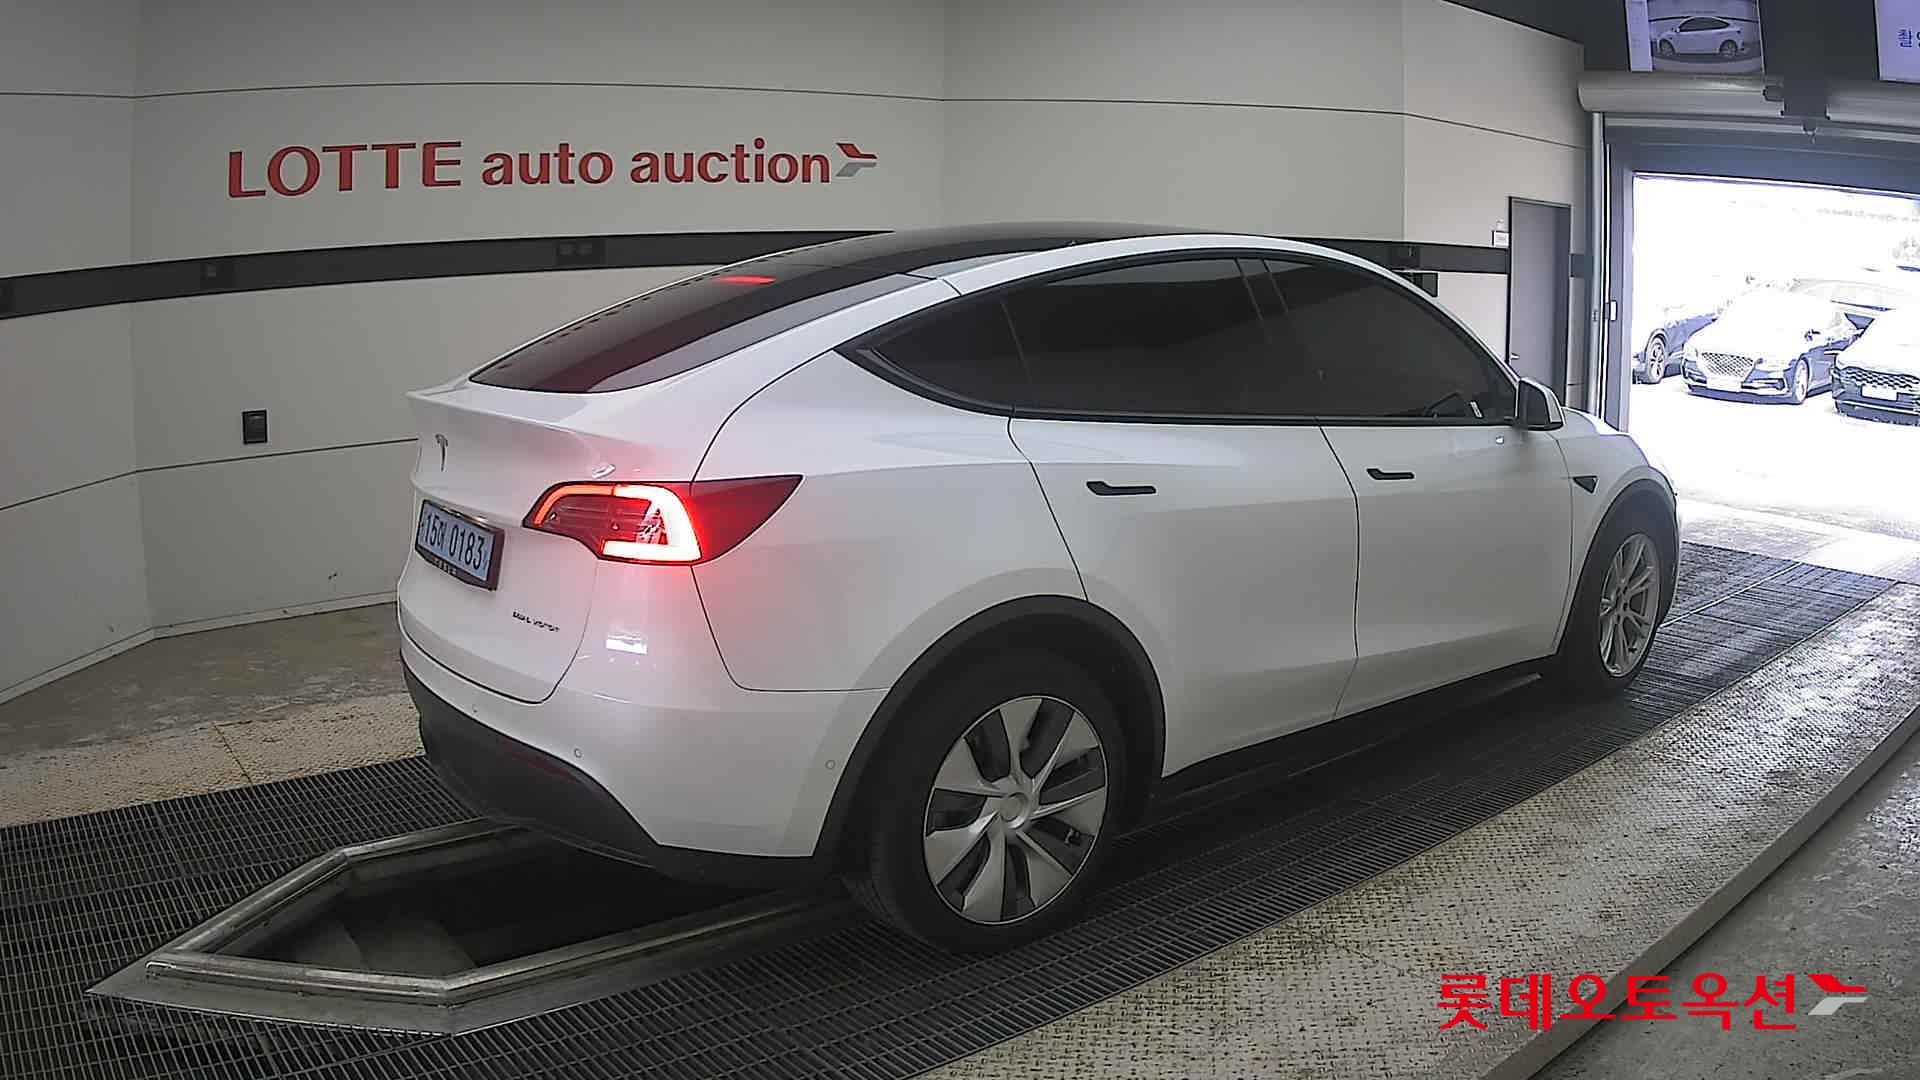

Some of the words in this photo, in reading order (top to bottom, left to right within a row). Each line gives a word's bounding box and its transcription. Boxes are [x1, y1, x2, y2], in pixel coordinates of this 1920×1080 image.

[230, 142, 463, 198] LOTTE
[482, 144, 614, 184] auto
[631, 139, 831, 184] auction
[449, 524, 485, 571] 0183
